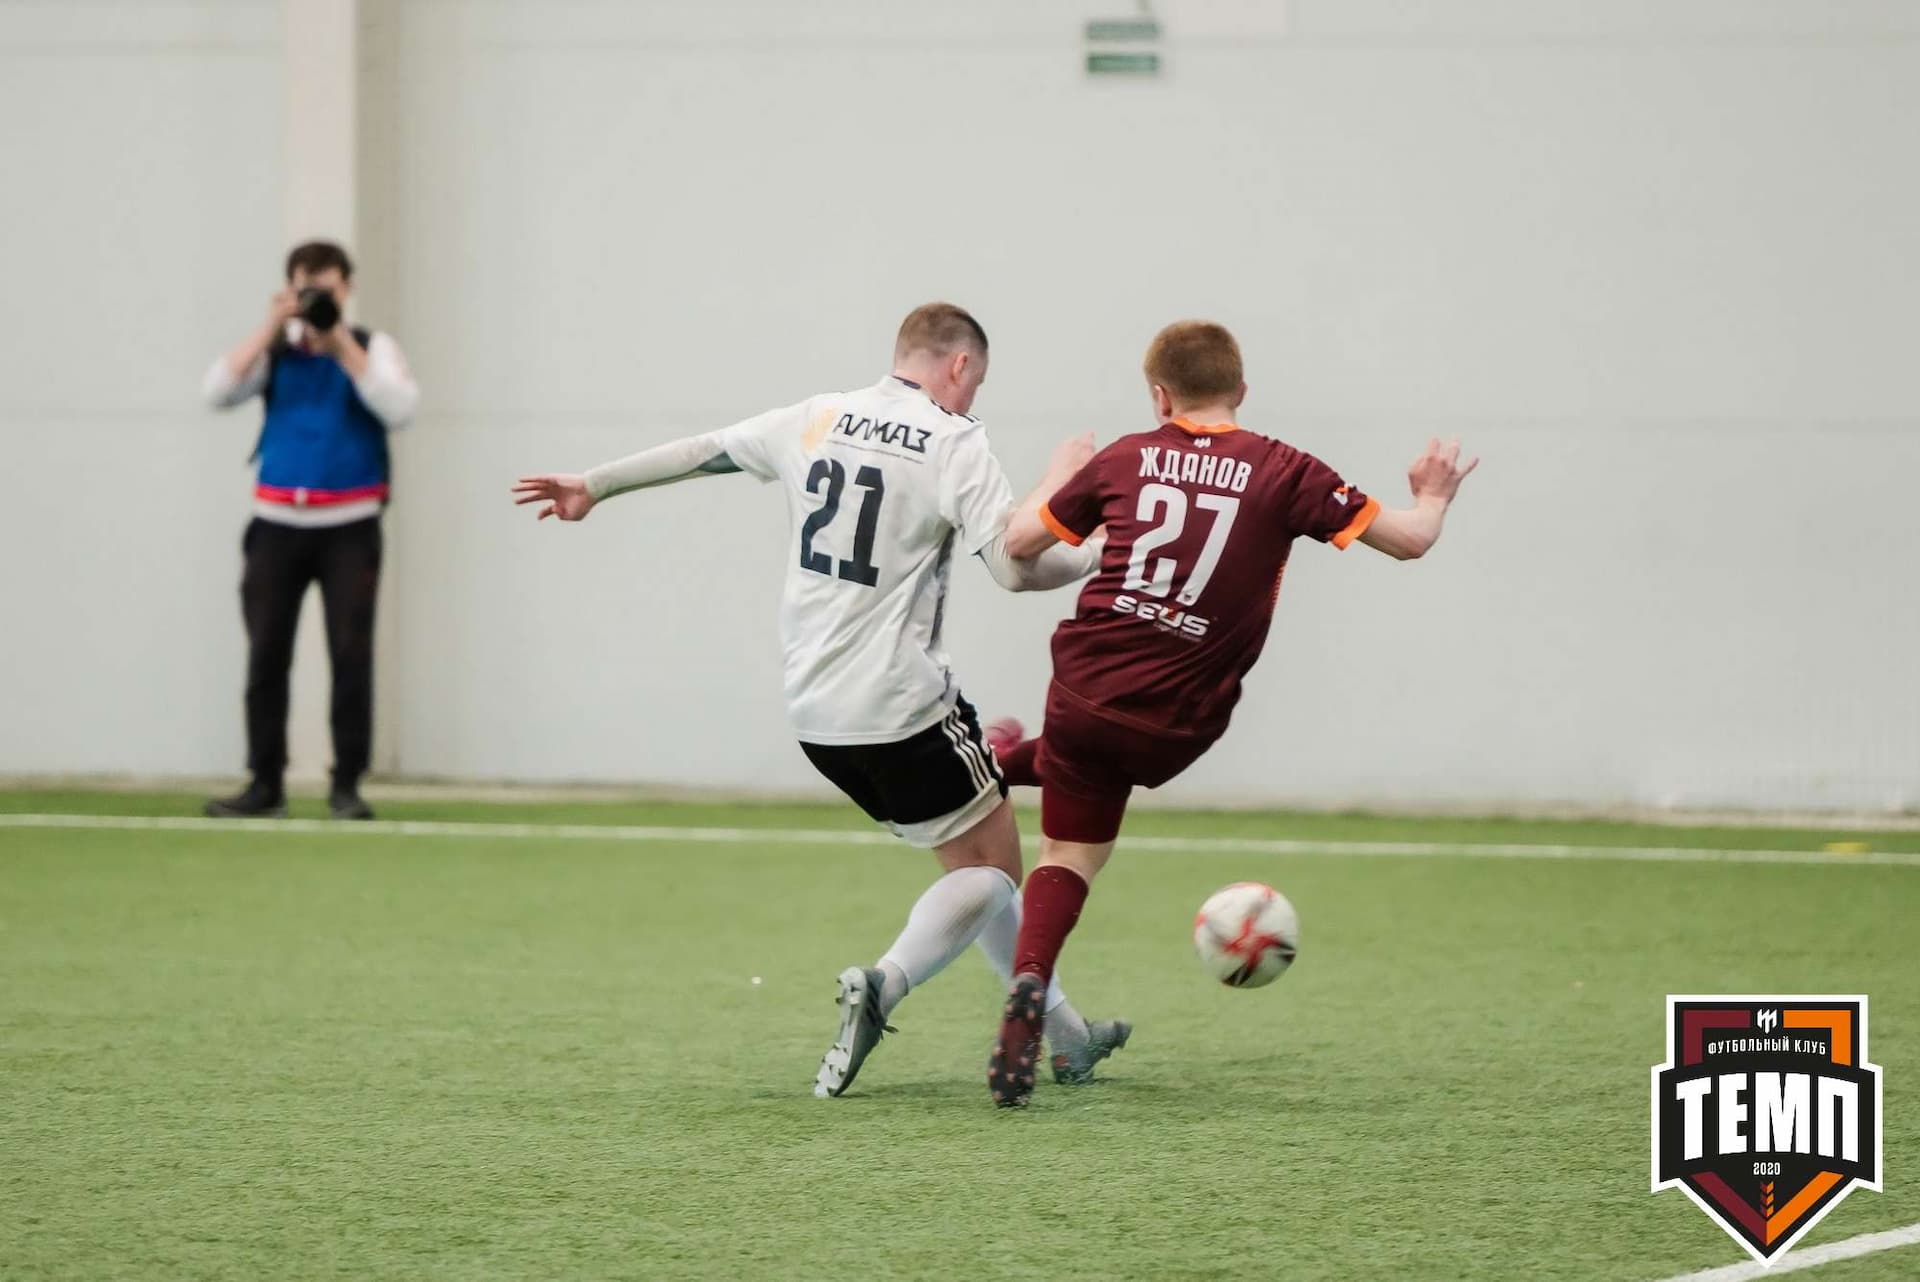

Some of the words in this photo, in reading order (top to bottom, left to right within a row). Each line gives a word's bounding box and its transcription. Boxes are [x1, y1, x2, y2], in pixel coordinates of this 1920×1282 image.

[833, 414, 932, 453] АЛМАЗ
[1138, 447, 1252, 493] ЖДАНОВ
[800, 458, 885, 587] 21
[1122, 483, 1240, 607] 27
[1112, 594, 1210, 637] SEUS
